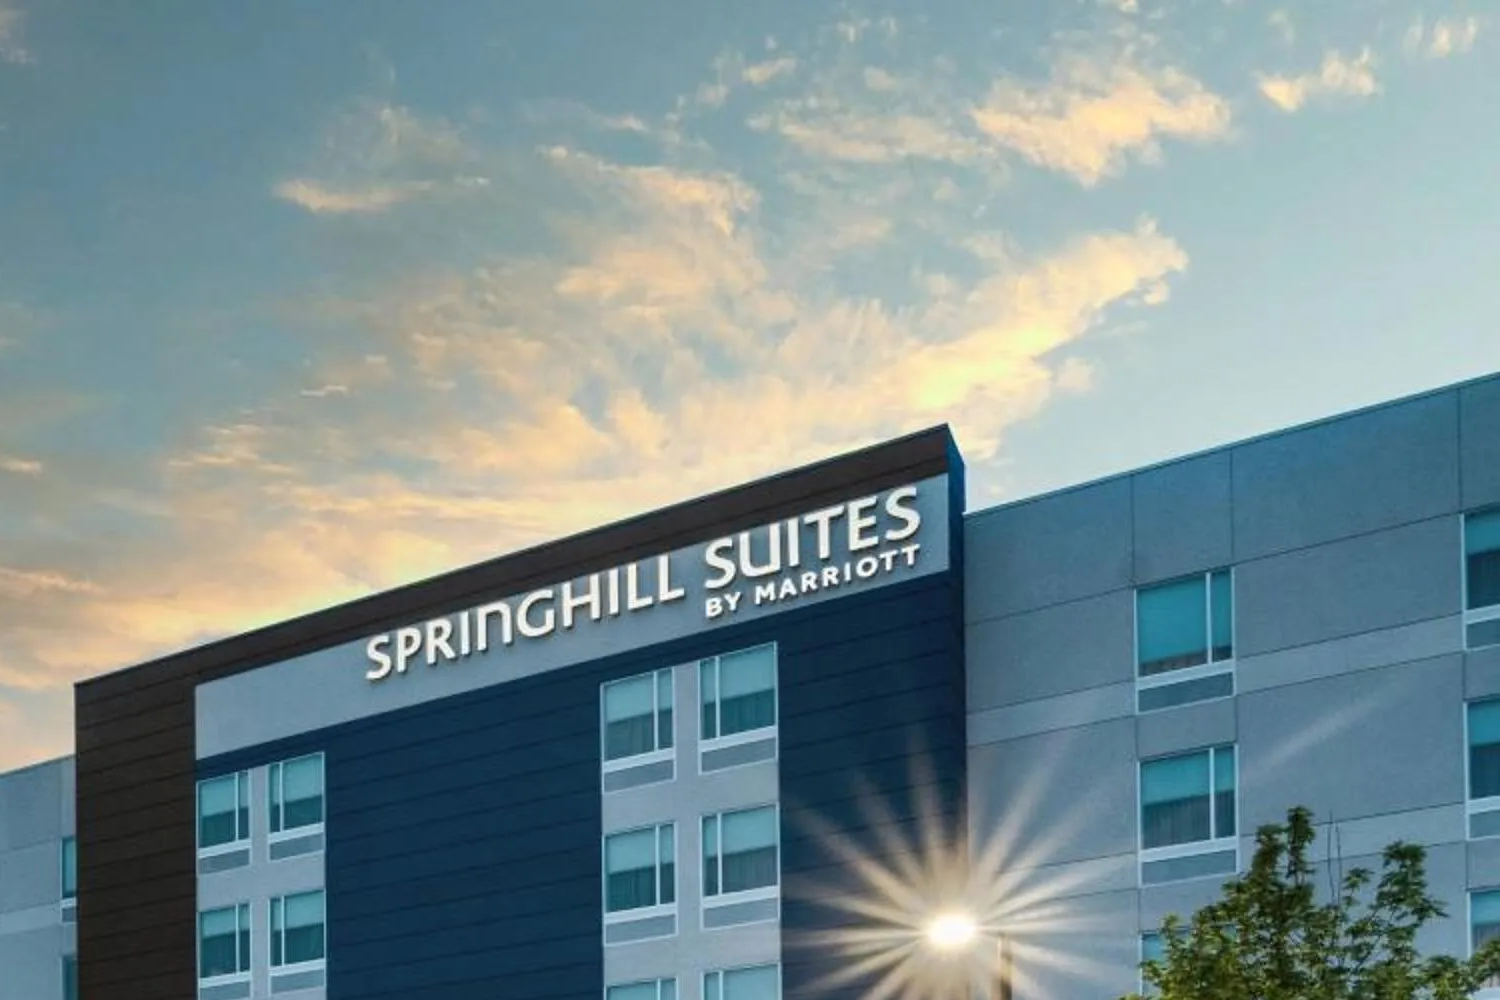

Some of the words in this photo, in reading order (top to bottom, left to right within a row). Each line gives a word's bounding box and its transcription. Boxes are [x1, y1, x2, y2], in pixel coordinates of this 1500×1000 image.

[365, 554, 686, 680] SPRINGHILL
[704, 486, 921, 589] SUITES
[705, 590, 742, 618] BY
[754, 543, 920, 605] MARRIOTT
